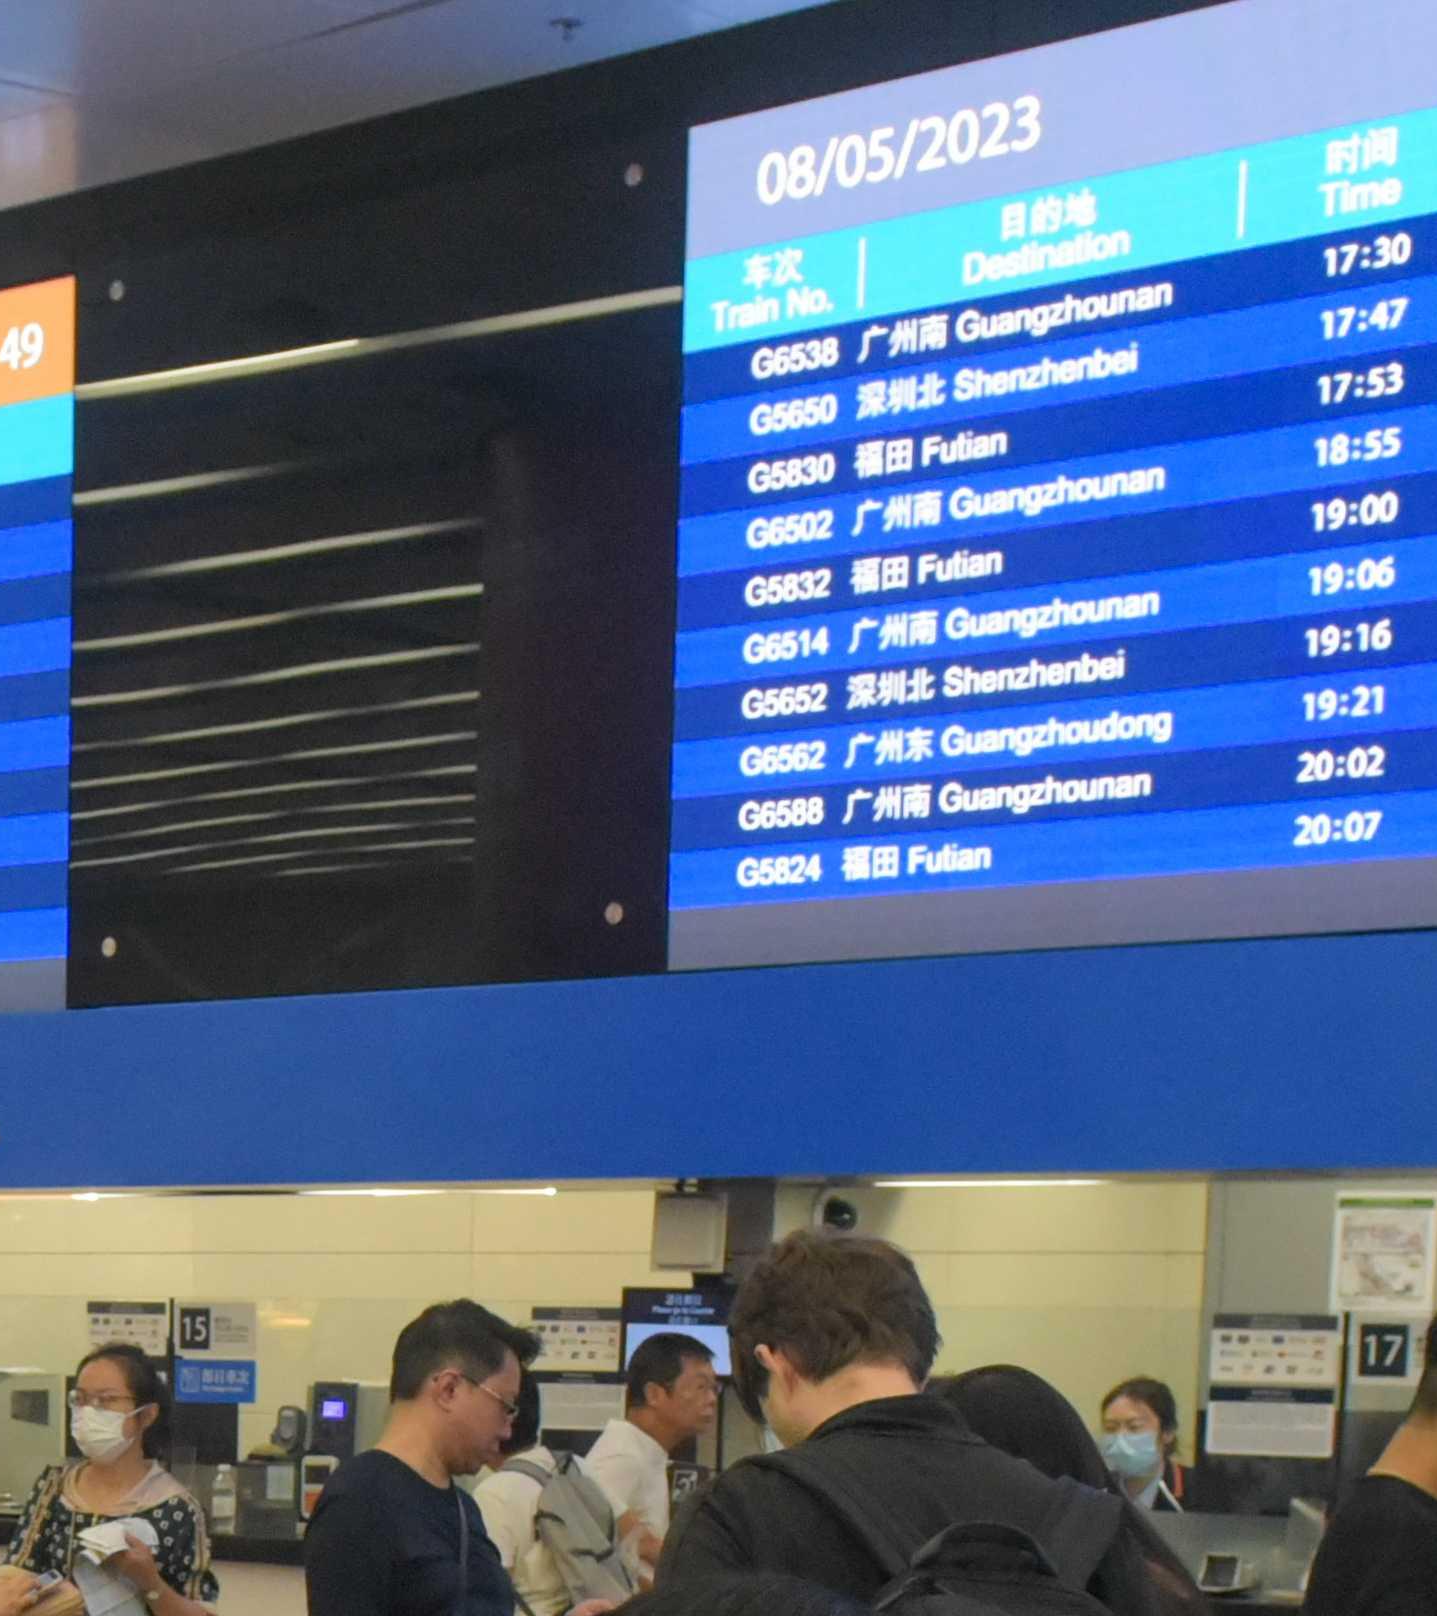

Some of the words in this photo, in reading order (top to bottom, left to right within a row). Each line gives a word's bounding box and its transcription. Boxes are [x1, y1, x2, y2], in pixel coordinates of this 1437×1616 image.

[756, 96, 1041, 205] 08/05/2023
[1326, 126, 1398, 174] 时间
[1319, 176, 1402, 219] Time
[962, 228, 1131, 288] Destination
[710, 292, 779, 333] Train
[784, 284, 834, 322] No.
[750, 338, 839, 380] G6538
[857, 313, 948, 363] 广州南
[954, 281, 1174, 344] Guangzhounan
[1322, 233, 1412, 277] 17:30
[748, 395, 838, 436] G5650
[855, 373, 946, 421] 深圳北
[953, 341, 1139, 403] Shenzhenbei
[1319, 298, 1409, 340] 17:47
[747, 453, 836, 494] G5830
[854, 439, 913, 480] 福田
[921, 429, 1008, 467] Futian
[1316, 364, 1405, 405] 17:53
[745, 510, 833, 550] G6502
[851, 491, 944, 537] 广州南
[948, 466, 1166, 521] Guangzhounan
[1313, 428, 1402, 467] 18:55
[744, 568, 832, 608] G5832
[850, 555, 910, 596] 福田
[917, 548, 1003, 586] Futian
[1310, 492, 1399, 533] 19:00
[742, 626, 830, 665] G6514
[848, 610, 938, 655] 广州南
[944, 591, 1161, 641] Guangzhounan
[1308, 555, 1396, 596] 19:06
[741, 683, 828, 720] G5652
[846, 672, 936, 711] 深圳北
[942, 649, 1127, 698] Shenzhenbei
[1304, 619, 1392, 658] 19:16
[739, 739, 826, 777] G6562
[843, 728, 935, 769] 广州东
[940, 710, 1174, 757] Guangzhoudong
[1301, 686, 1385, 722] 19:21
[738, 796, 824, 832] G6588
[842, 784, 933, 824] 广州南
[938, 771, 1153, 816] Guangzhounan
[1295, 746, 1385, 784] 20:02
[736, 853, 823, 888] G5824
[841, 844, 900, 882] 福田
[907, 841, 992, 875] Futian
[1293, 811, 1382, 847] 20:07
[182, 1315, 207, 1342] 15
[1364, 1334, 1404, 1367] 17
